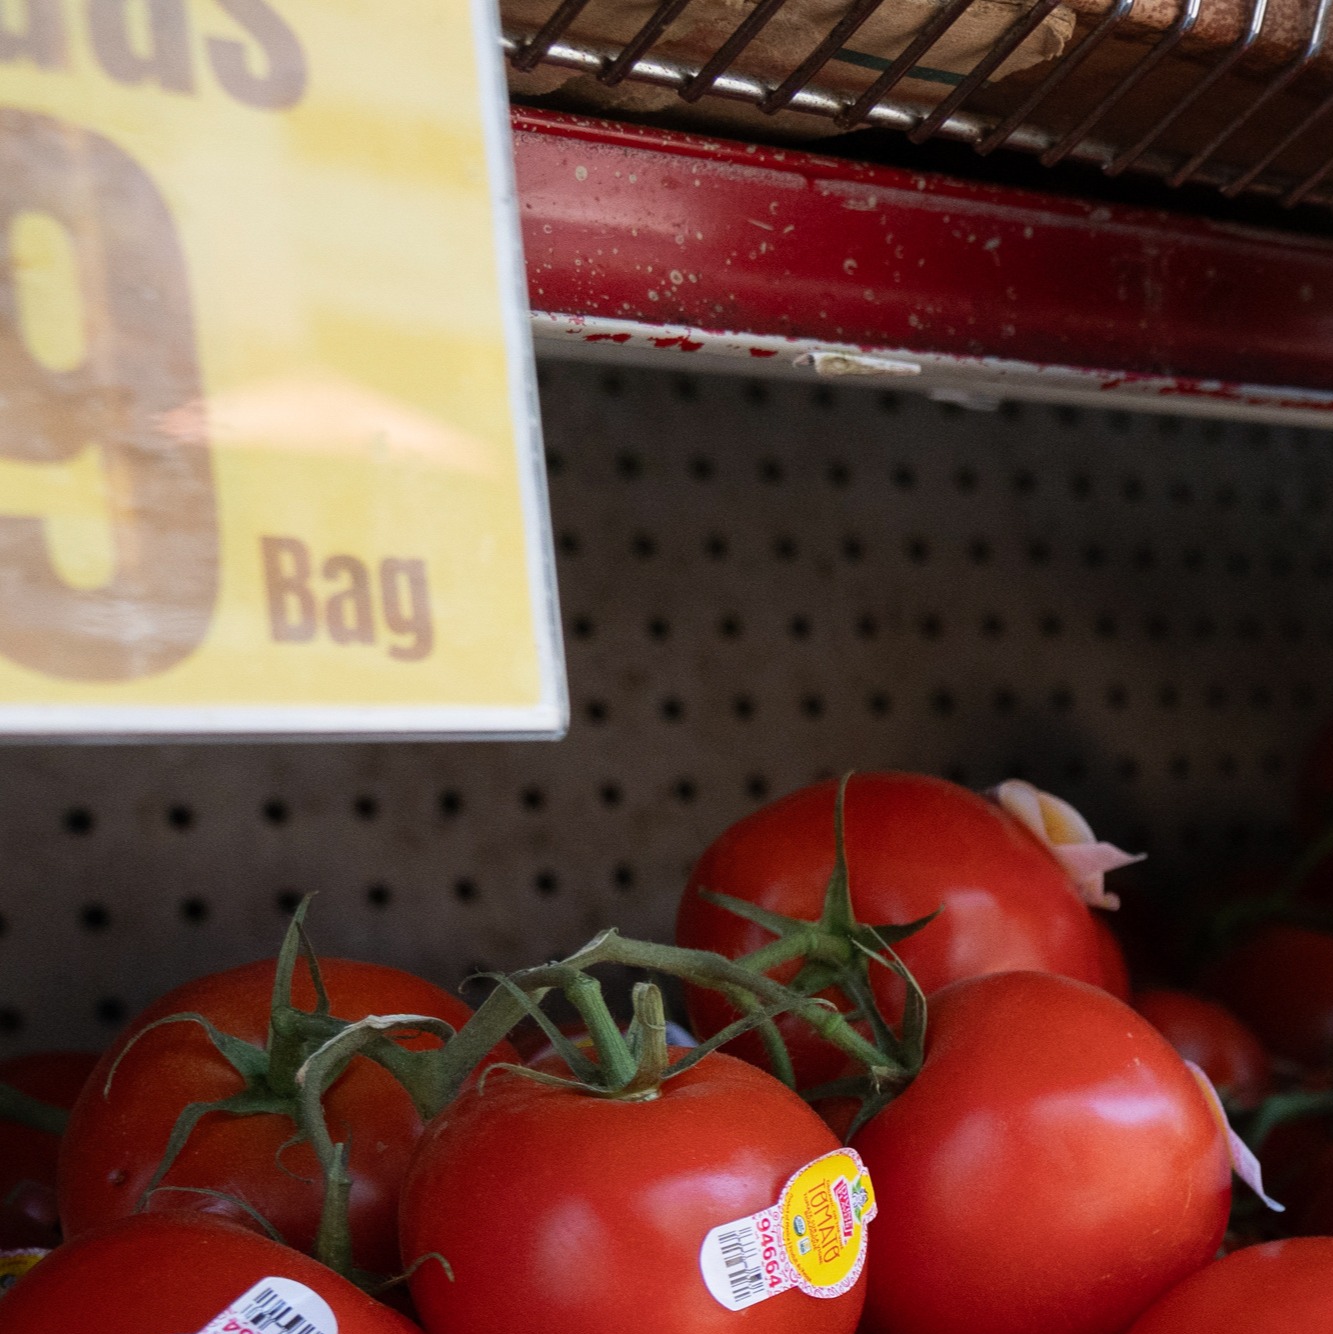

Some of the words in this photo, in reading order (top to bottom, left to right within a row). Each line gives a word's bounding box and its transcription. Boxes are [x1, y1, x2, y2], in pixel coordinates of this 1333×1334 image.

[260, 535, 436, 661] Bag
[756, 1217, 783, 1288] 94664
[807, 1179, 841, 1263] TOMATO
